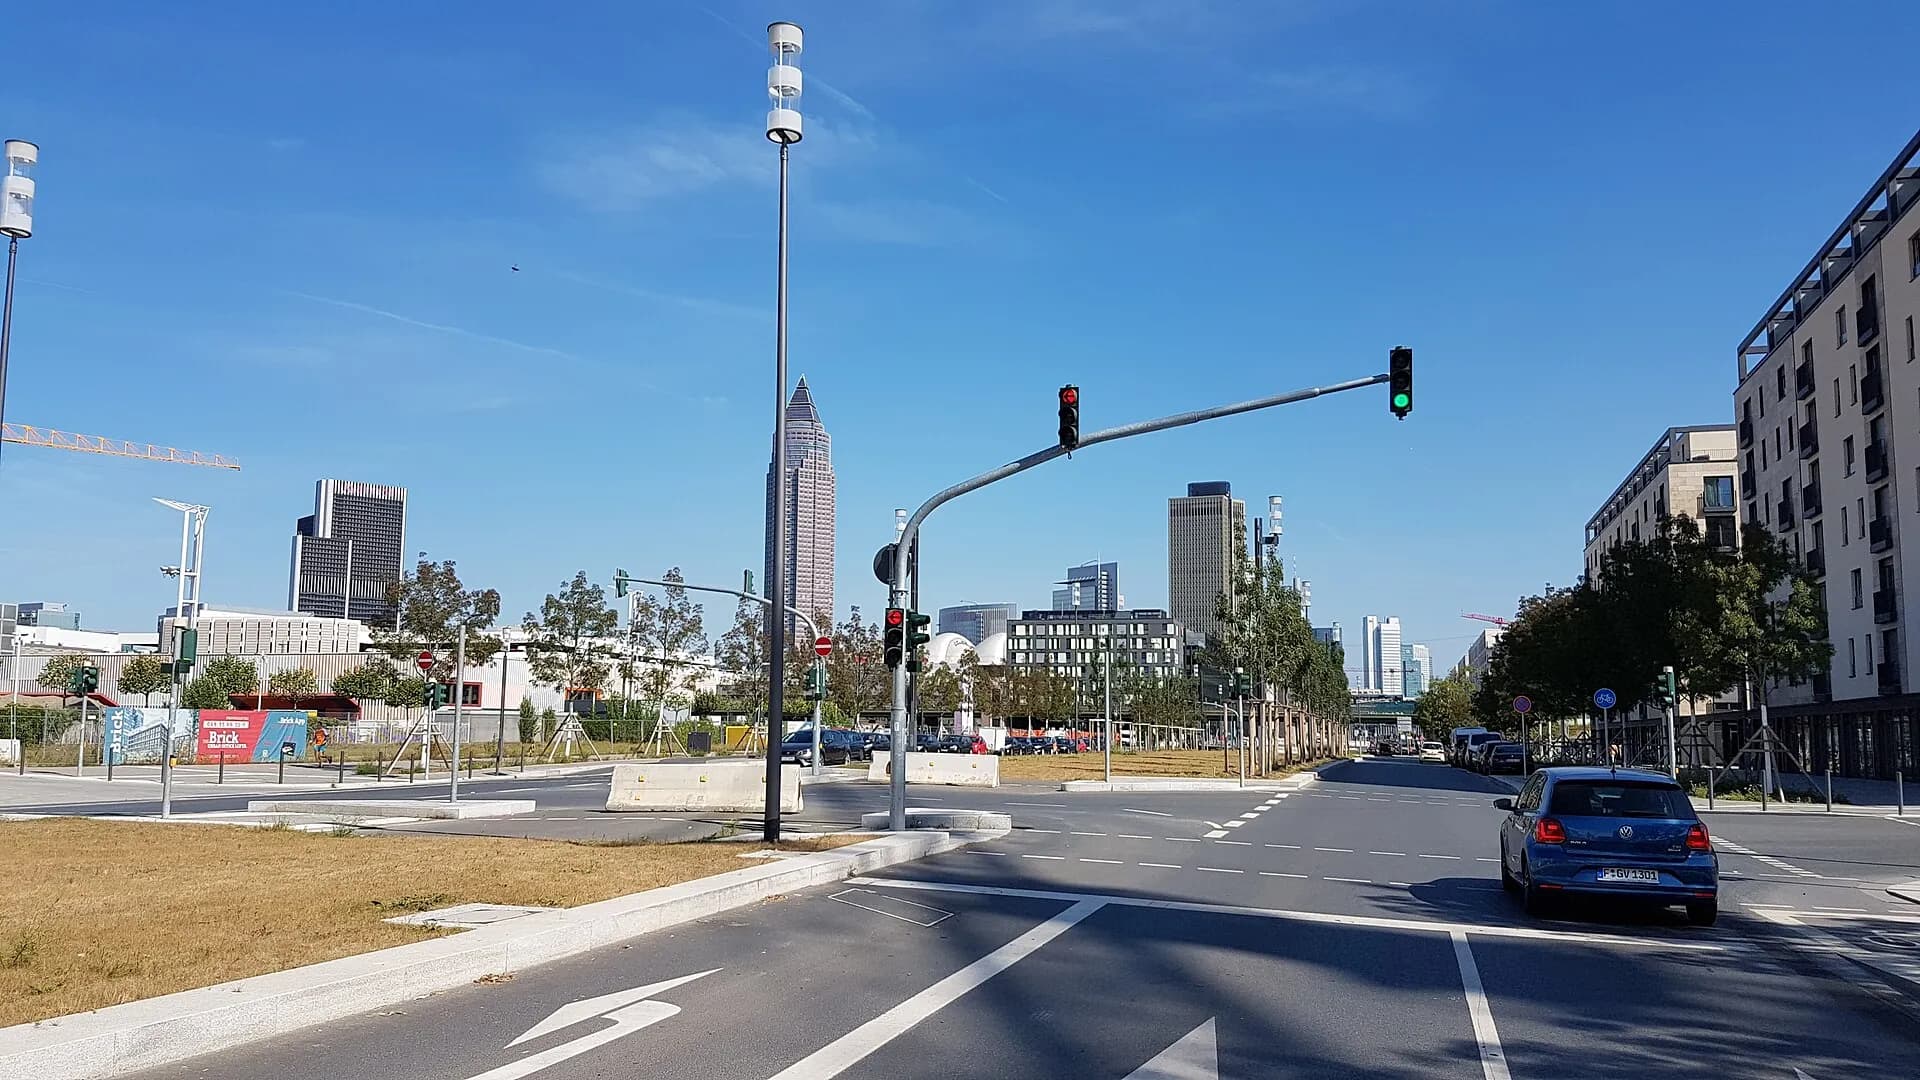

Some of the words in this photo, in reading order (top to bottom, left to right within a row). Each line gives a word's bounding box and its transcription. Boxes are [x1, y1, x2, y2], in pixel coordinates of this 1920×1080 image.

[110, 709, 123, 753] Brick
[209, 730, 239, 743] Brick
[1632, 870, 1658, 880] 1301
